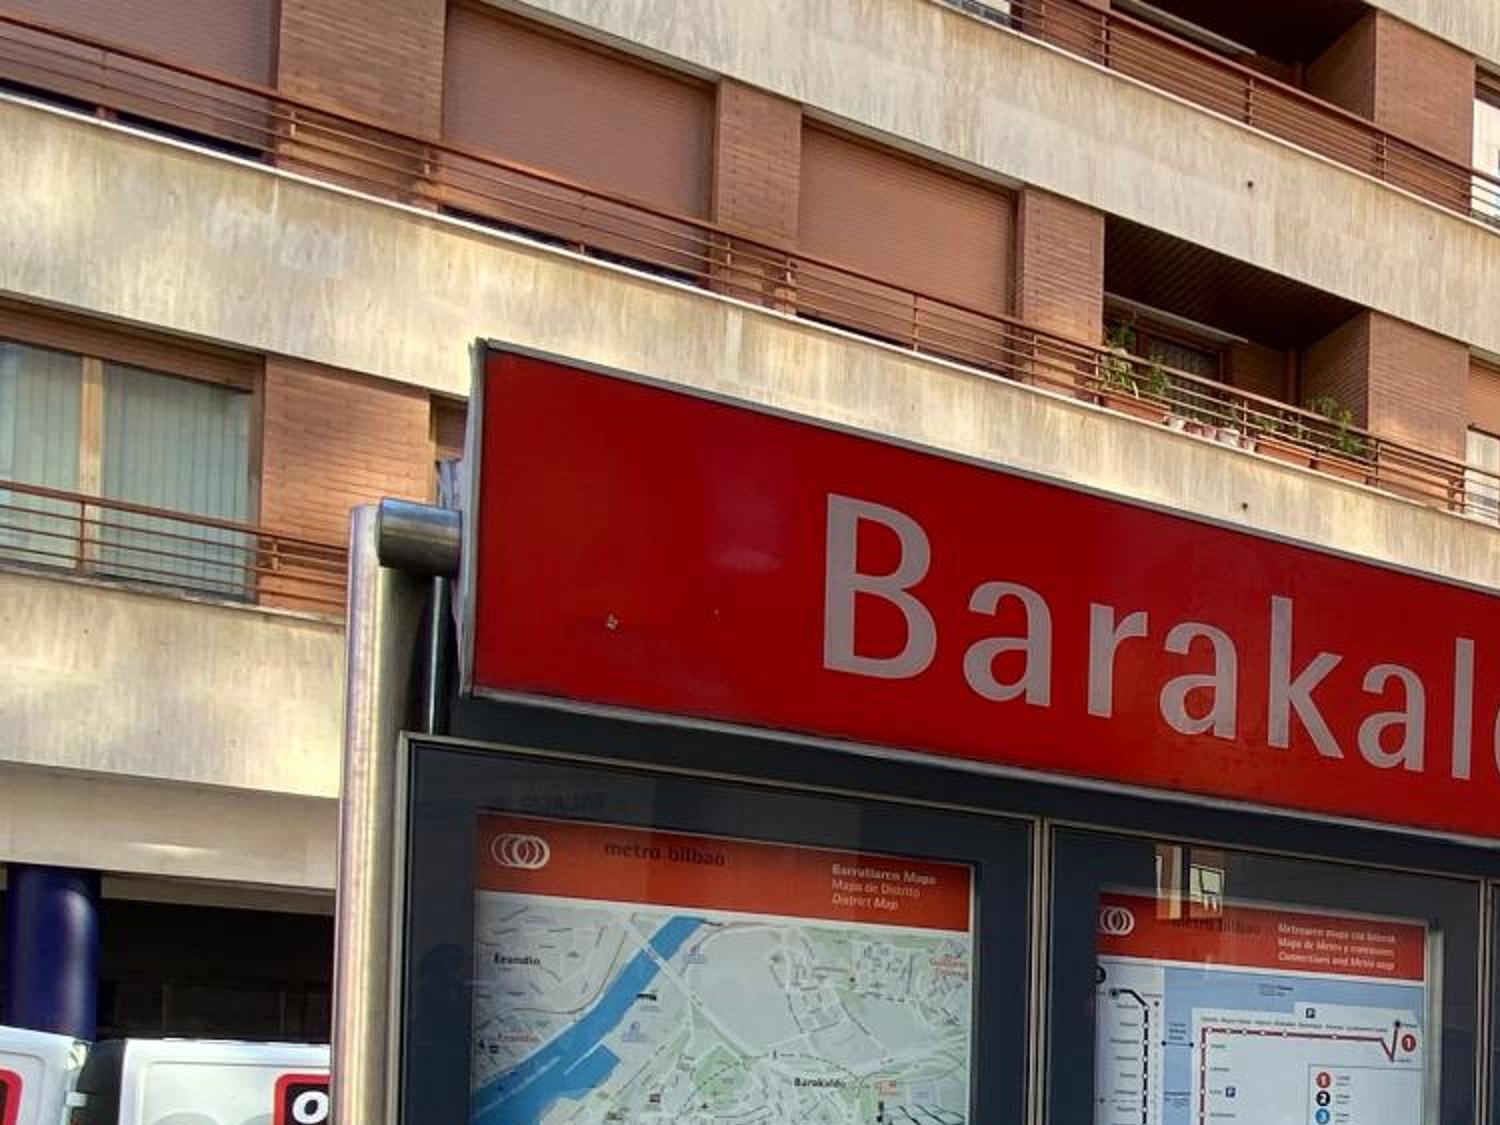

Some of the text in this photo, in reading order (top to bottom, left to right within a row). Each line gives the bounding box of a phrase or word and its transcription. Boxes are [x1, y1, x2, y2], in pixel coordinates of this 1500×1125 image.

[605, 842, 726, 866] metro bilbao
[903, 870, 937, 886] Mapa
[832, 879, 864, 896] Mapa
[832, 893, 899, 912] District Map
